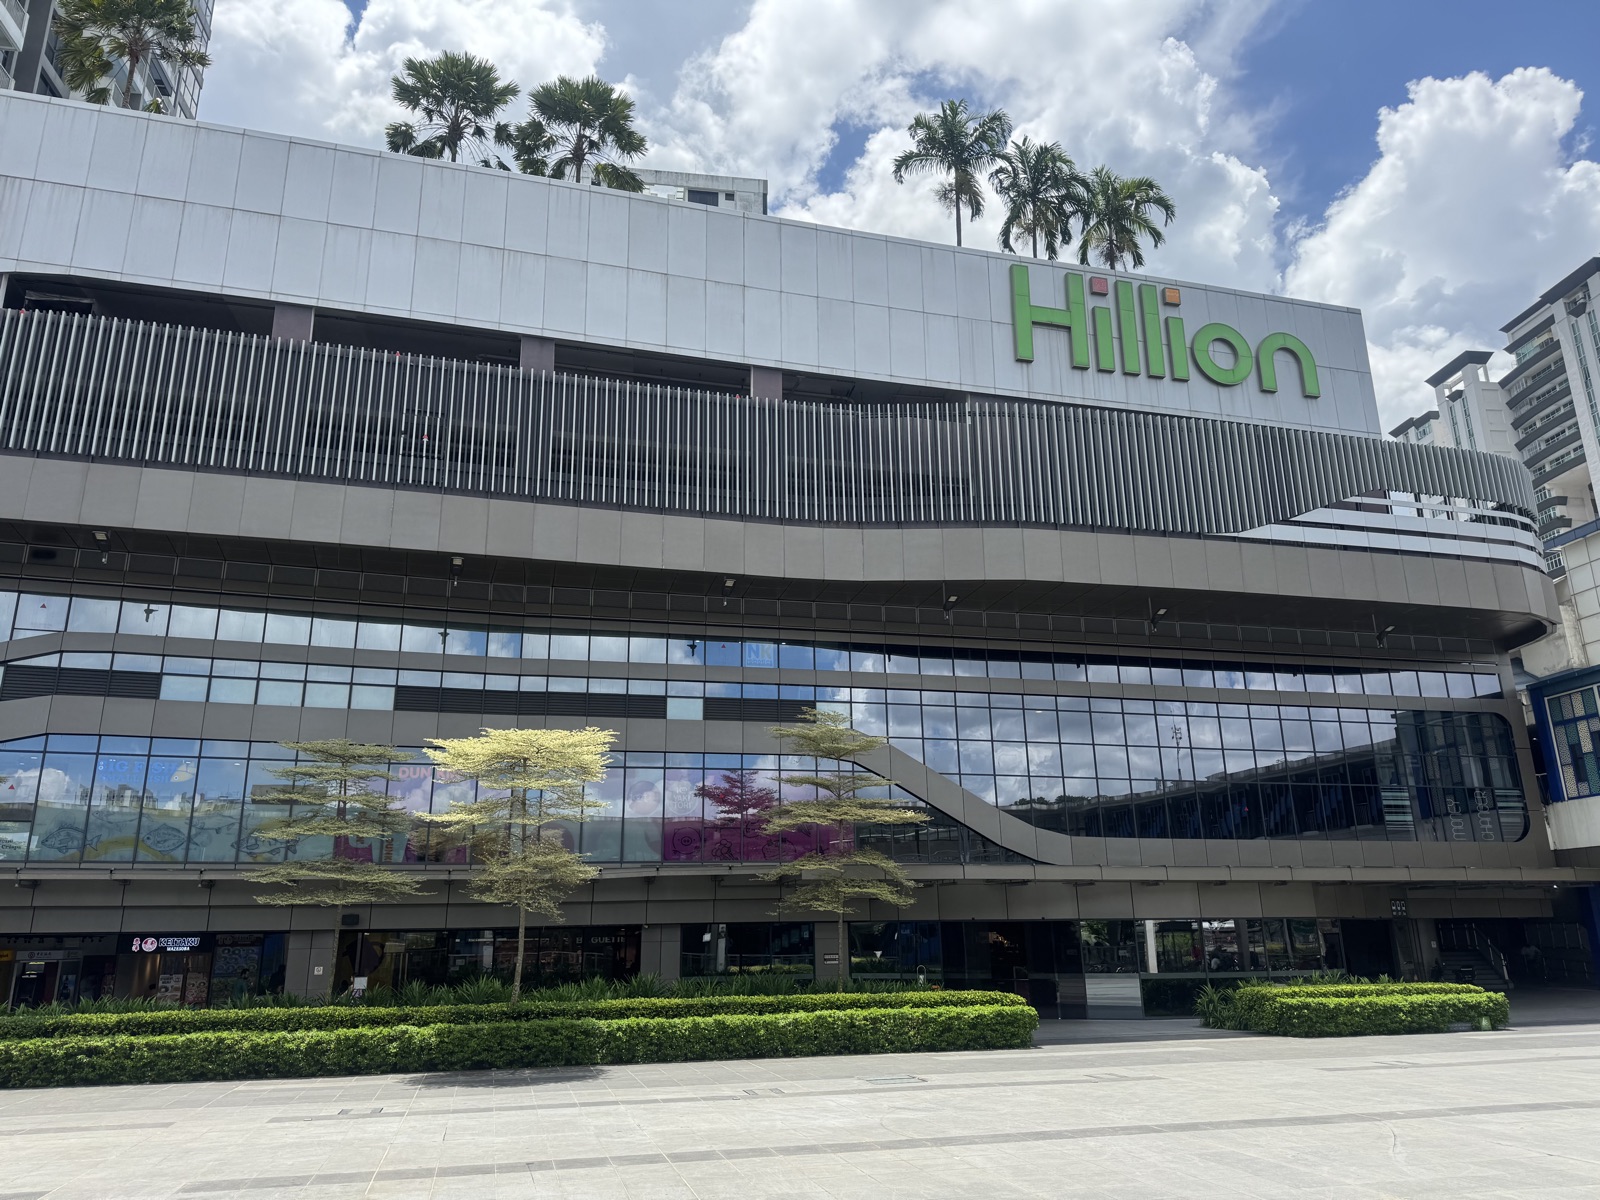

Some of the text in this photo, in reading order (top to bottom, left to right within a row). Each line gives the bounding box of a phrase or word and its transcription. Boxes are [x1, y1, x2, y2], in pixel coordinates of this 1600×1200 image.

[1009, 263, 1321, 399] Hillion
[134, 762, 177, 773] FSH
[672, 801, 691, 809] TORI
[1446, 798, 1467, 841] MONEY
[158, 937, 200, 947] KEITAKU
[576, 936, 626, 944] BGUETTE
